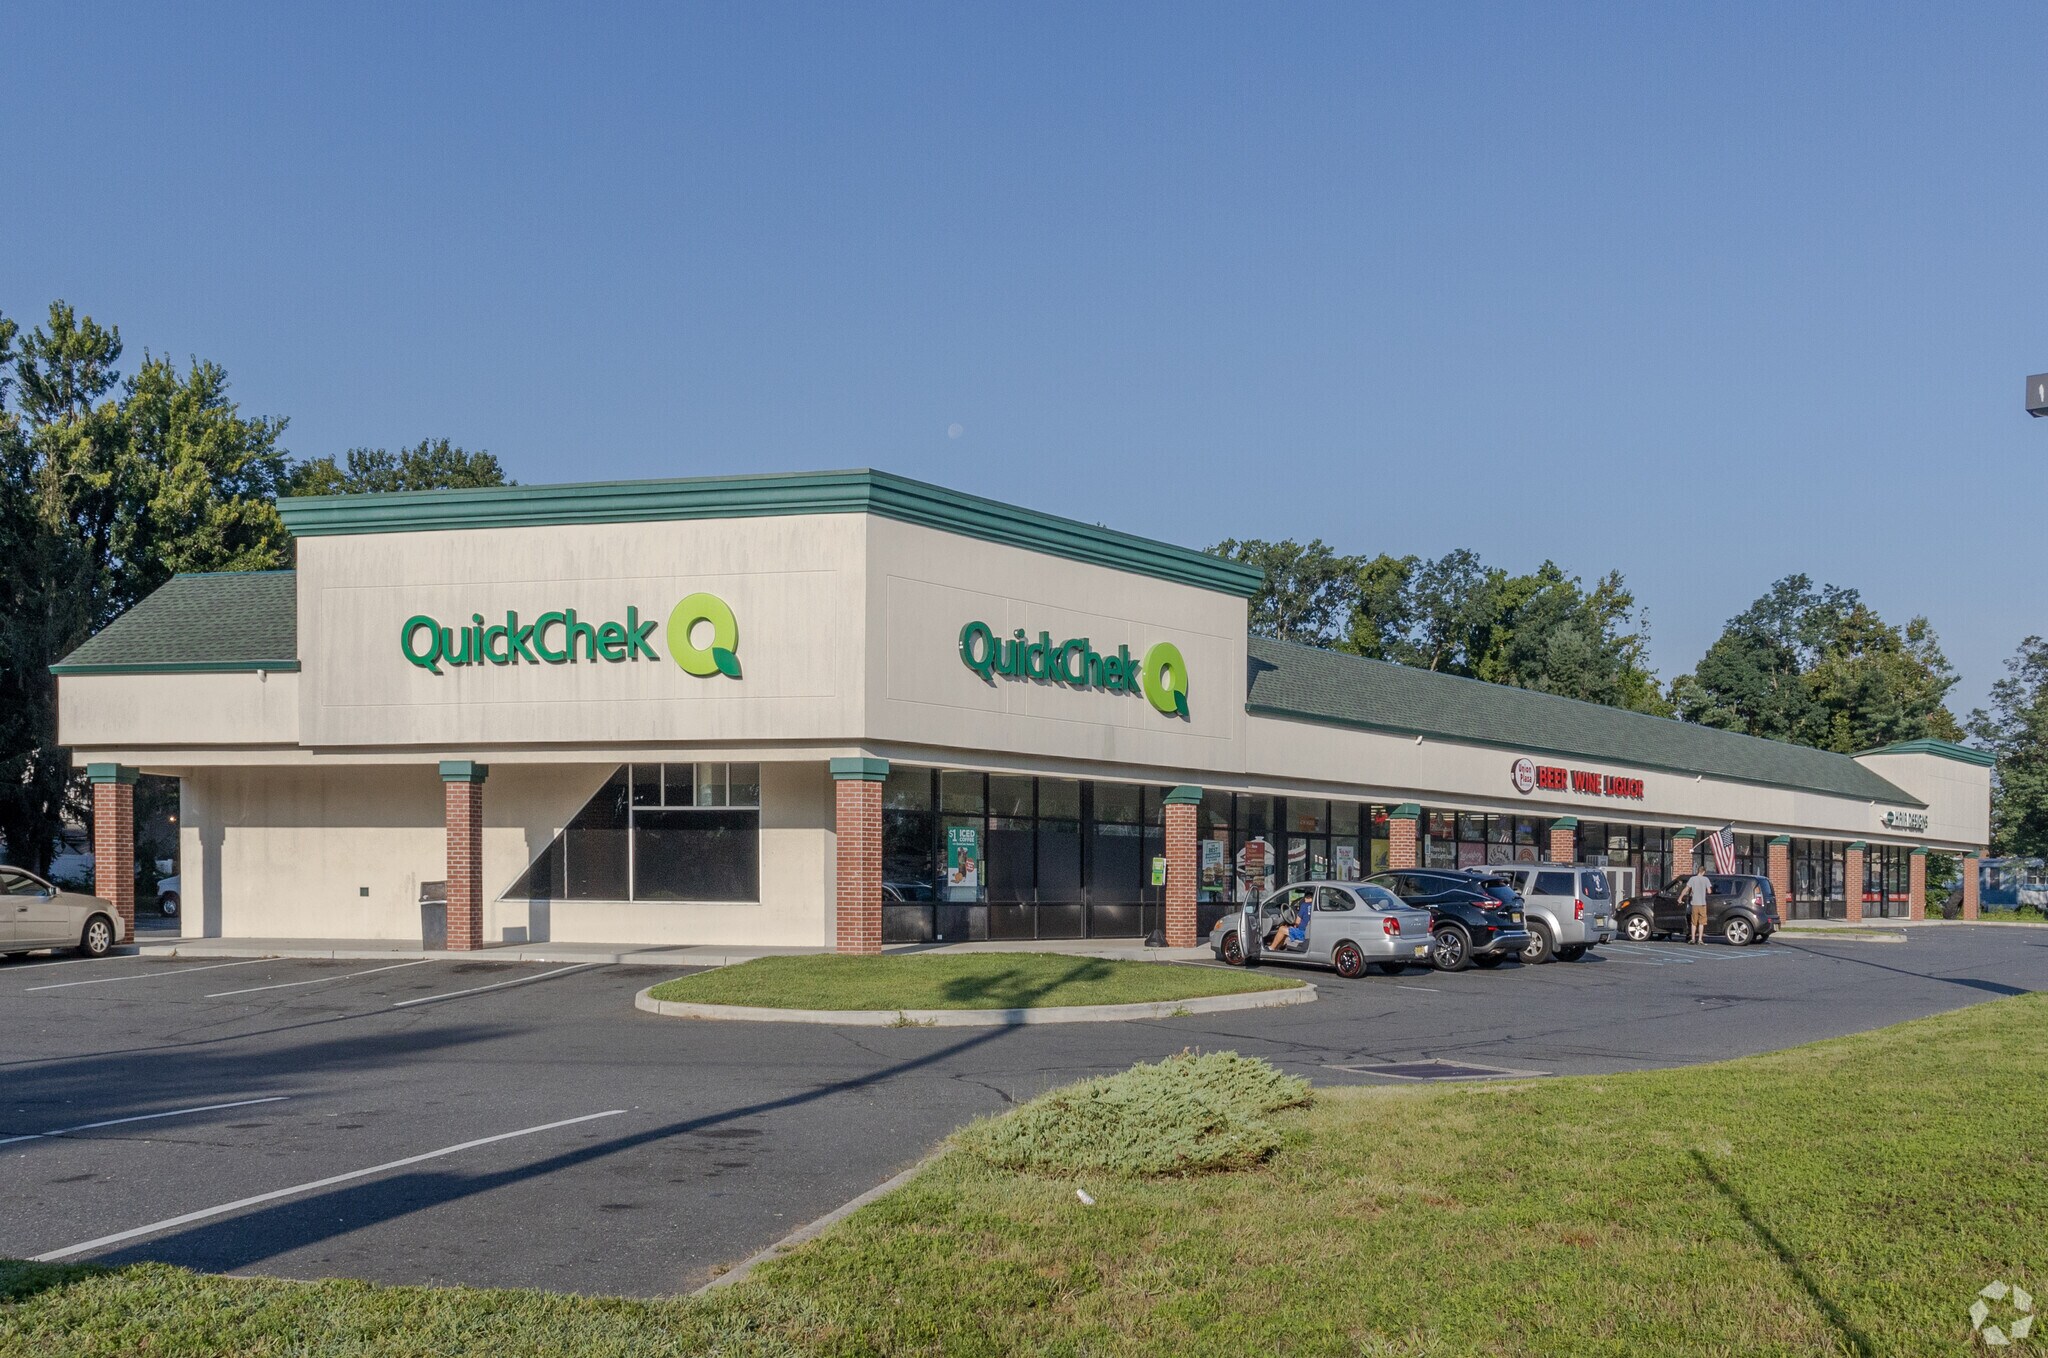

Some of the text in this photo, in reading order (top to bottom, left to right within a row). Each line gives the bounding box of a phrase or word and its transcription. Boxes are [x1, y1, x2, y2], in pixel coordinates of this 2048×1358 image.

[401, 605, 660, 675] QuickChek
[959, 620, 1141, 693] QuickChek
[1537, 766, 1644, 798] BEER WINE LIQUOR
[948, 829, 975, 842] $1 ICED
